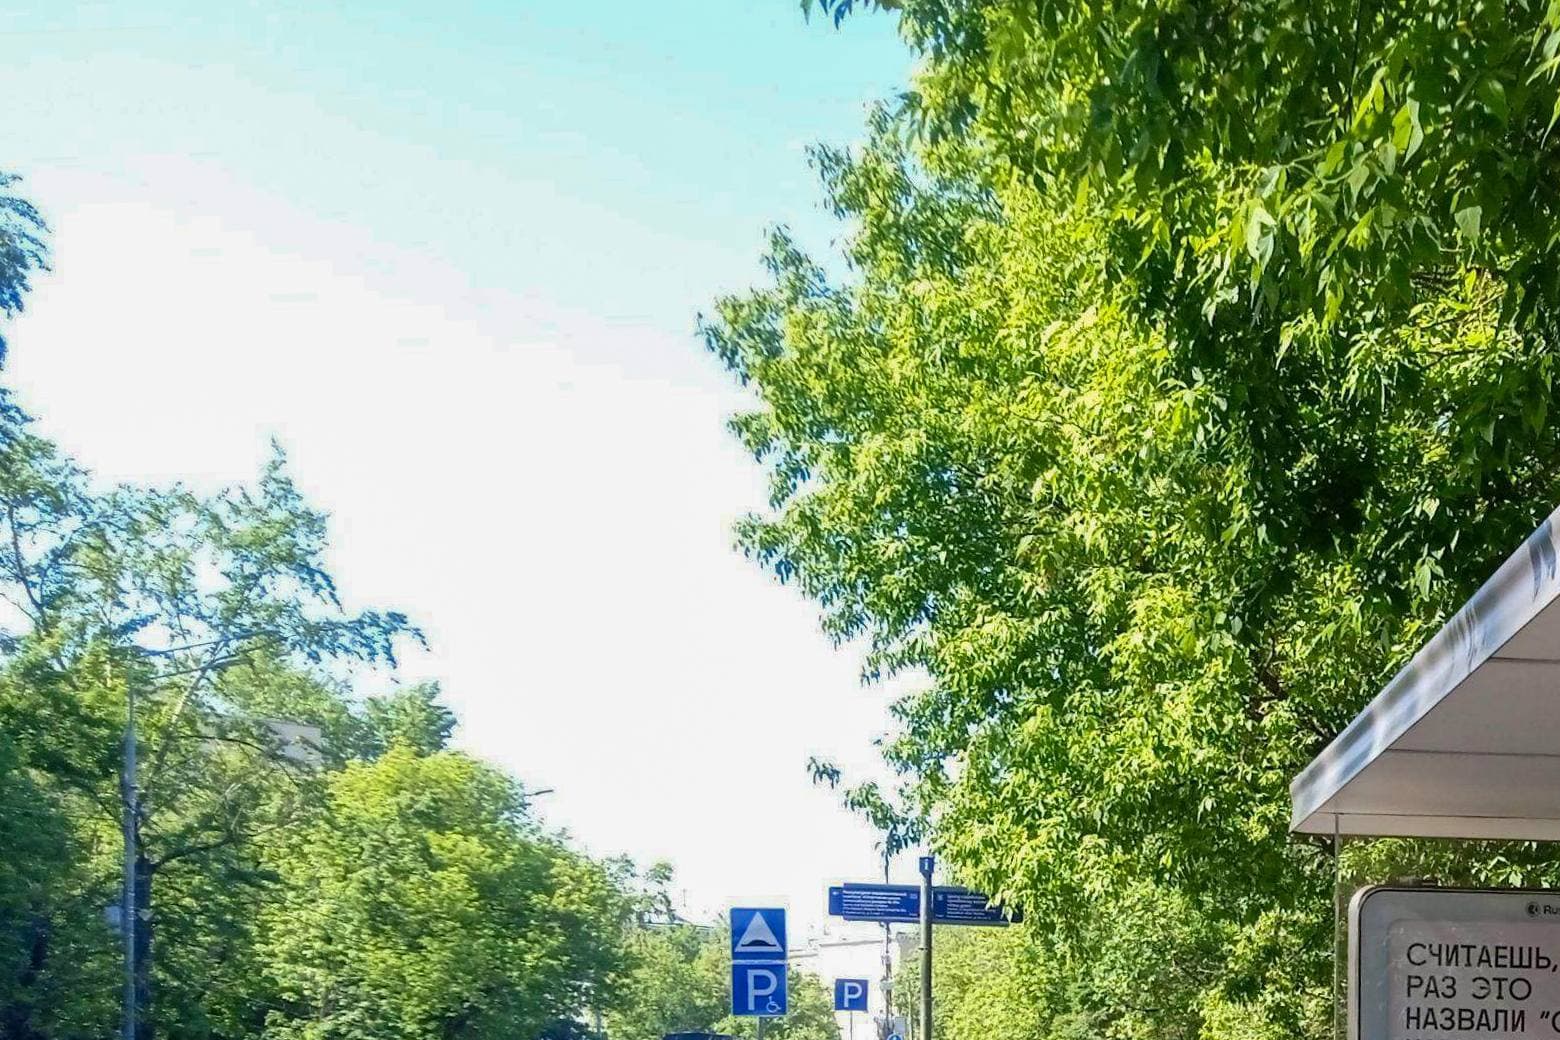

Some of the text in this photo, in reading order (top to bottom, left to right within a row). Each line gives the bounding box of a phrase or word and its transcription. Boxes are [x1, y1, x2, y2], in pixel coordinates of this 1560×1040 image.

[1406, 942, 1559, 973] СЧИТАЕШЬ,
[1406, 974, 1532, 1001] РАЗ ЭТО
[1405, 1006, 1526, 1033] НАЗВАЛИ
